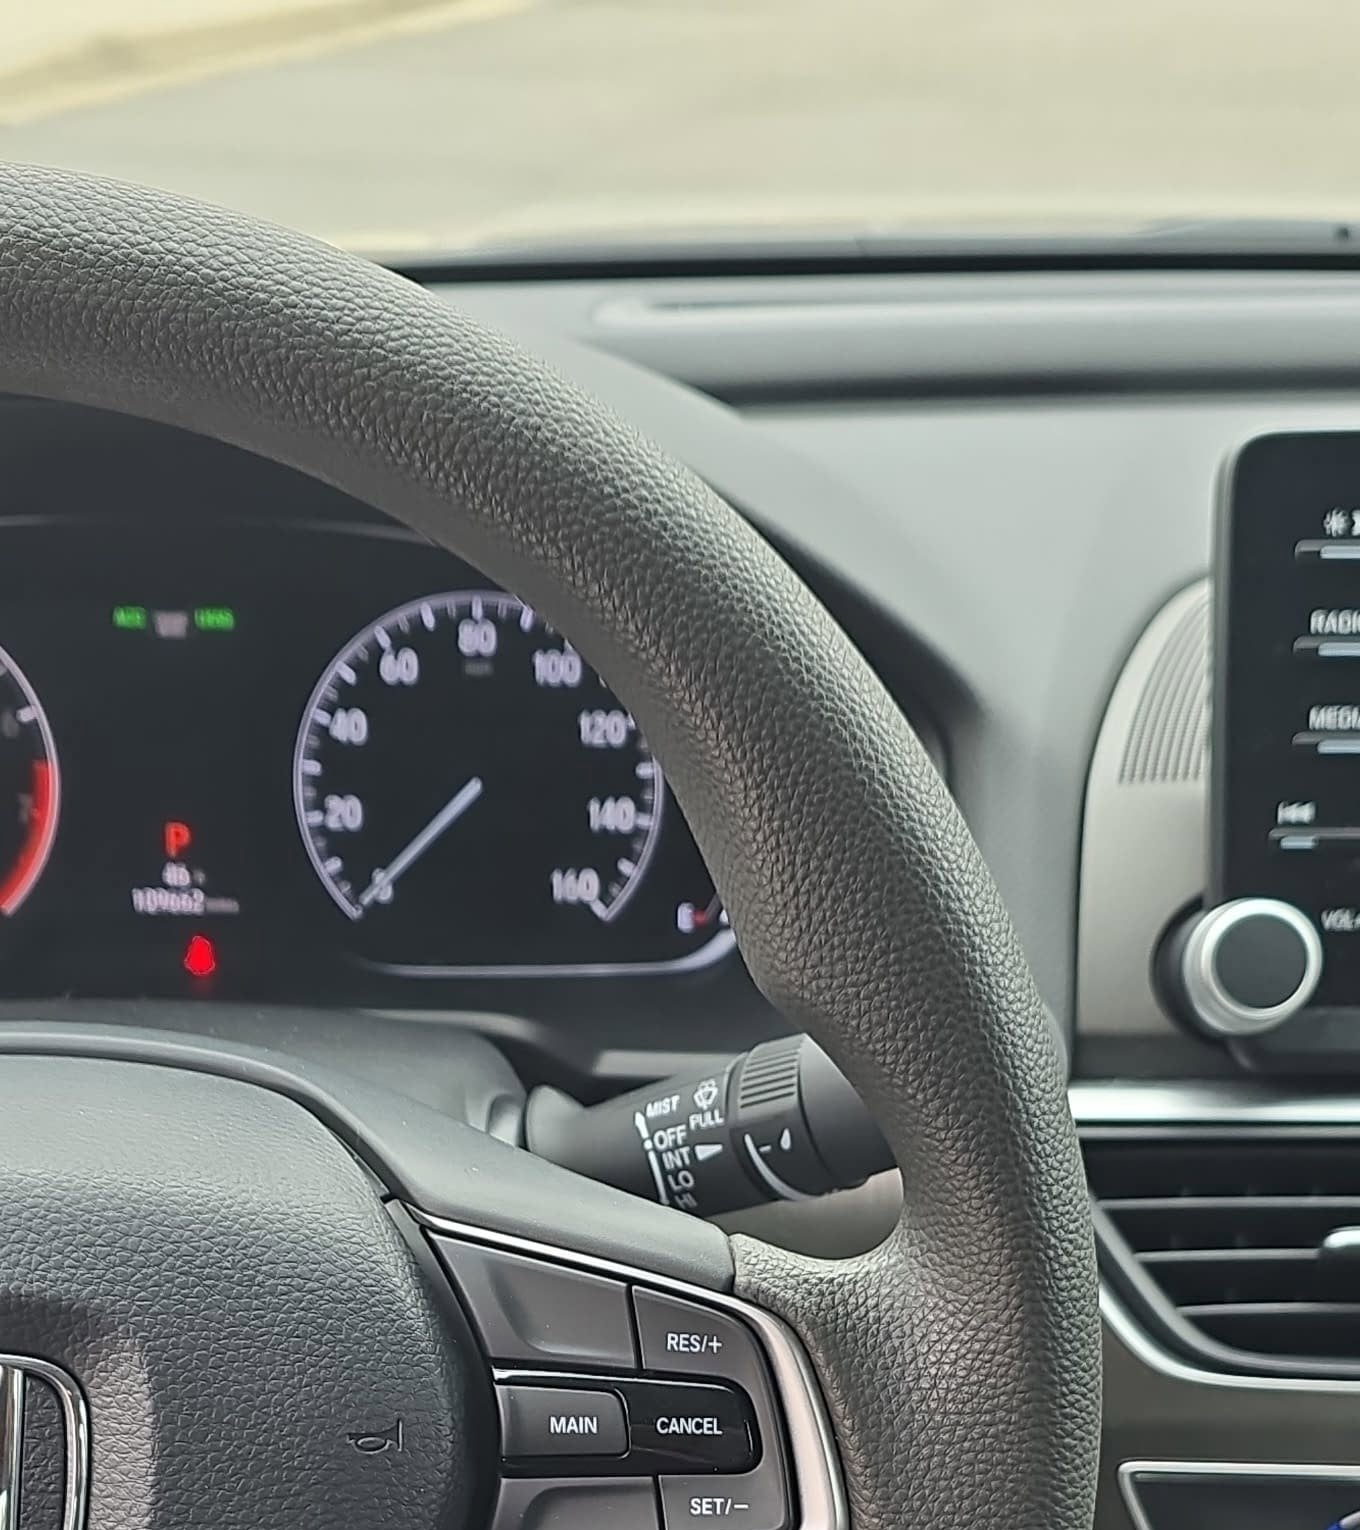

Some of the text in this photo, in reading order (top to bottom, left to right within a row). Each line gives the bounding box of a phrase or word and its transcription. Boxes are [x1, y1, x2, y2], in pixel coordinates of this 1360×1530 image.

[458, 618, 497, 656] 80
[378, 647, 419, 686] 60
[533, 649, 583, 688] 100
[329, 706, 369, 746] 40
[578, 709, 629, 749] 120
[323, 793, 364, 832] 20
[588, 796, 637, 834] 140
[164, 820, 191, 858] P
[551, 868, 601, 905] 160
[645, 1094, 681, 1119] MIST
[653, 1123, 688, 1151] OFF
[662, 1146, 692, 1171] INT
[668, 1170, 695, 1191] LO
[666, 1333, 723, 1354] RES/+
[549, 1416, 598, 1435] MAIN
[655, 1416, 723, 1435] CANCEL
